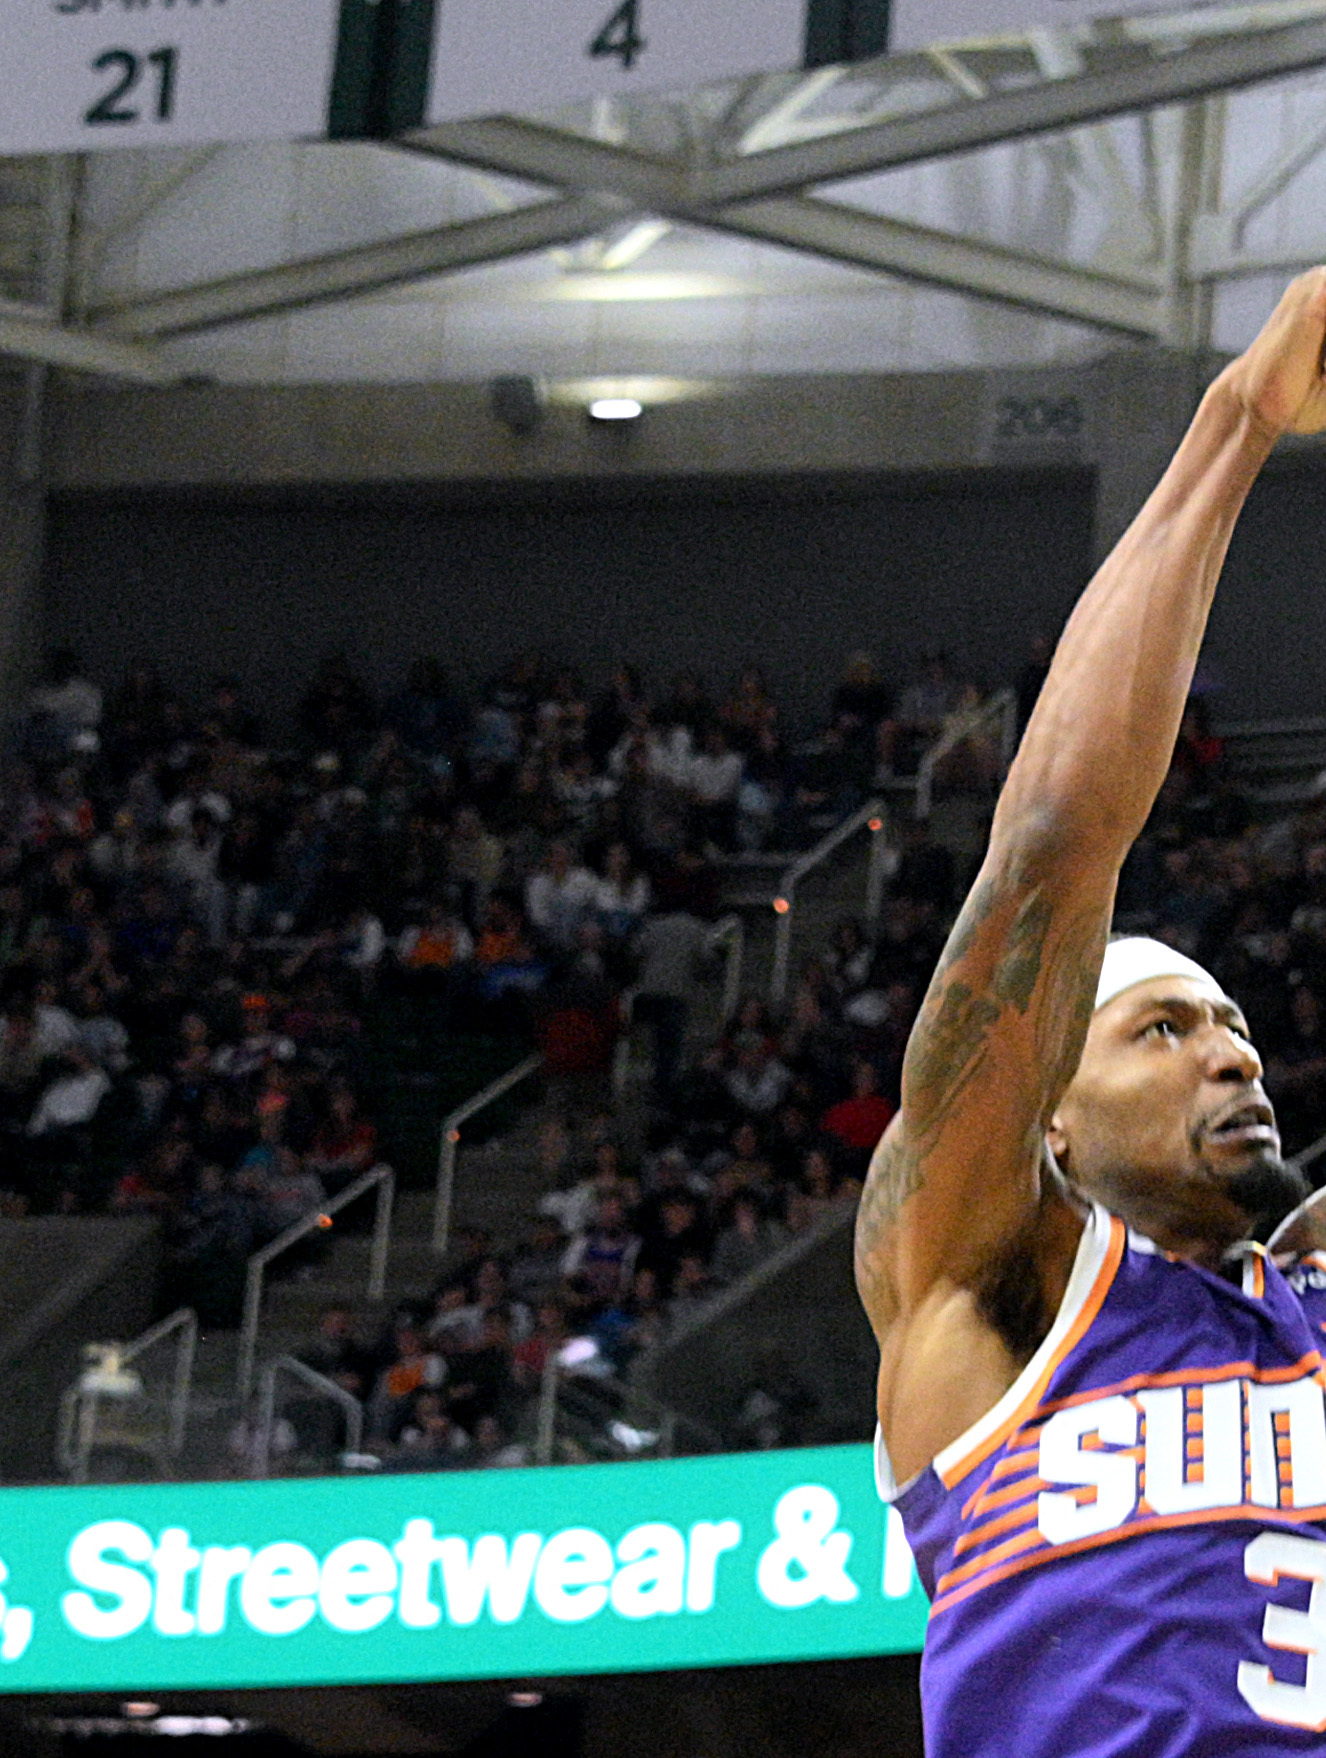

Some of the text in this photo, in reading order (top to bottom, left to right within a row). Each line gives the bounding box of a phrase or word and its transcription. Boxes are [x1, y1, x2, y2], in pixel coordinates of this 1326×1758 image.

[588, 0, 646, 70] 4
[83, 46, 180, 127] 21
[63, 1519, 741, 1638] Streetwear
[758, 1485, 858, 1607] &
